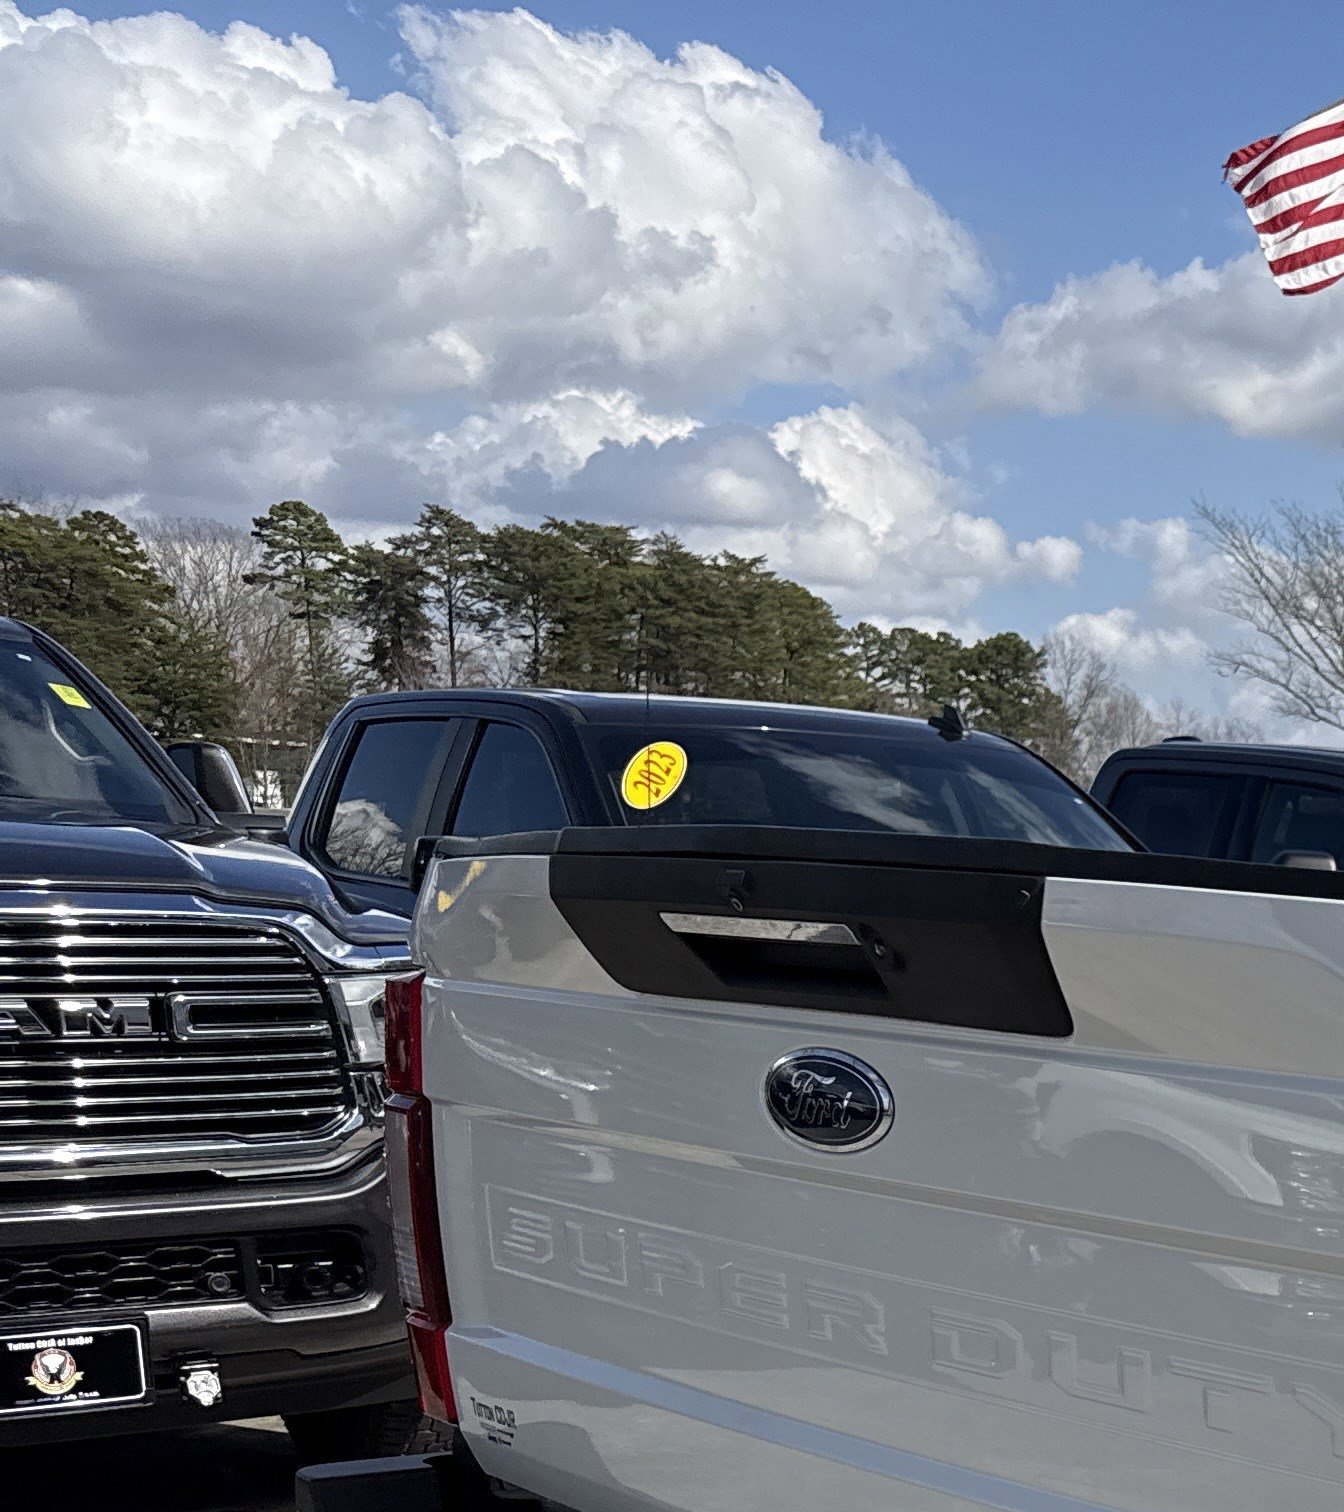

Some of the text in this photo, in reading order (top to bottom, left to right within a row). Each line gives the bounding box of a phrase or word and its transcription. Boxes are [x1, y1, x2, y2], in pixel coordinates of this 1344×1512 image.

[633, 750, 677, 798] 2023
[778, 1069, 852, 1130] Ford
[500, 1205, 891, 1356] SUPER
